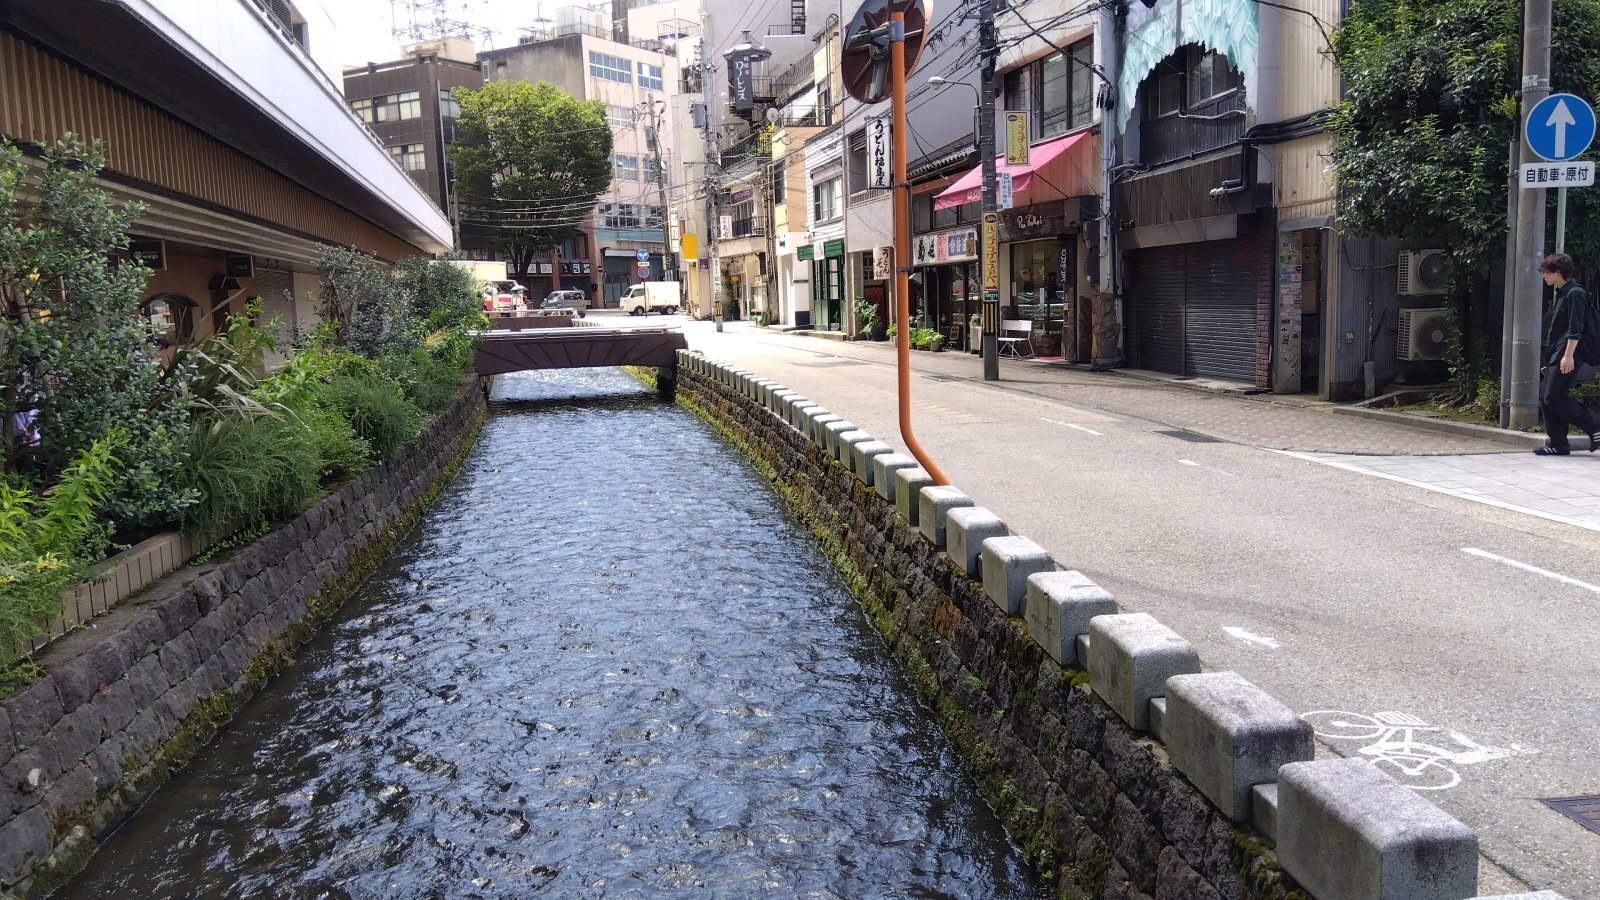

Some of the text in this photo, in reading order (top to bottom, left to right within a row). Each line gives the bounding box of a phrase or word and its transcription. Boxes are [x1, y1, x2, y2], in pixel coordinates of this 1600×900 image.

[1526, 166, 1588, 182] 自動車・原付
[882, 249, 890, 273] うどん
